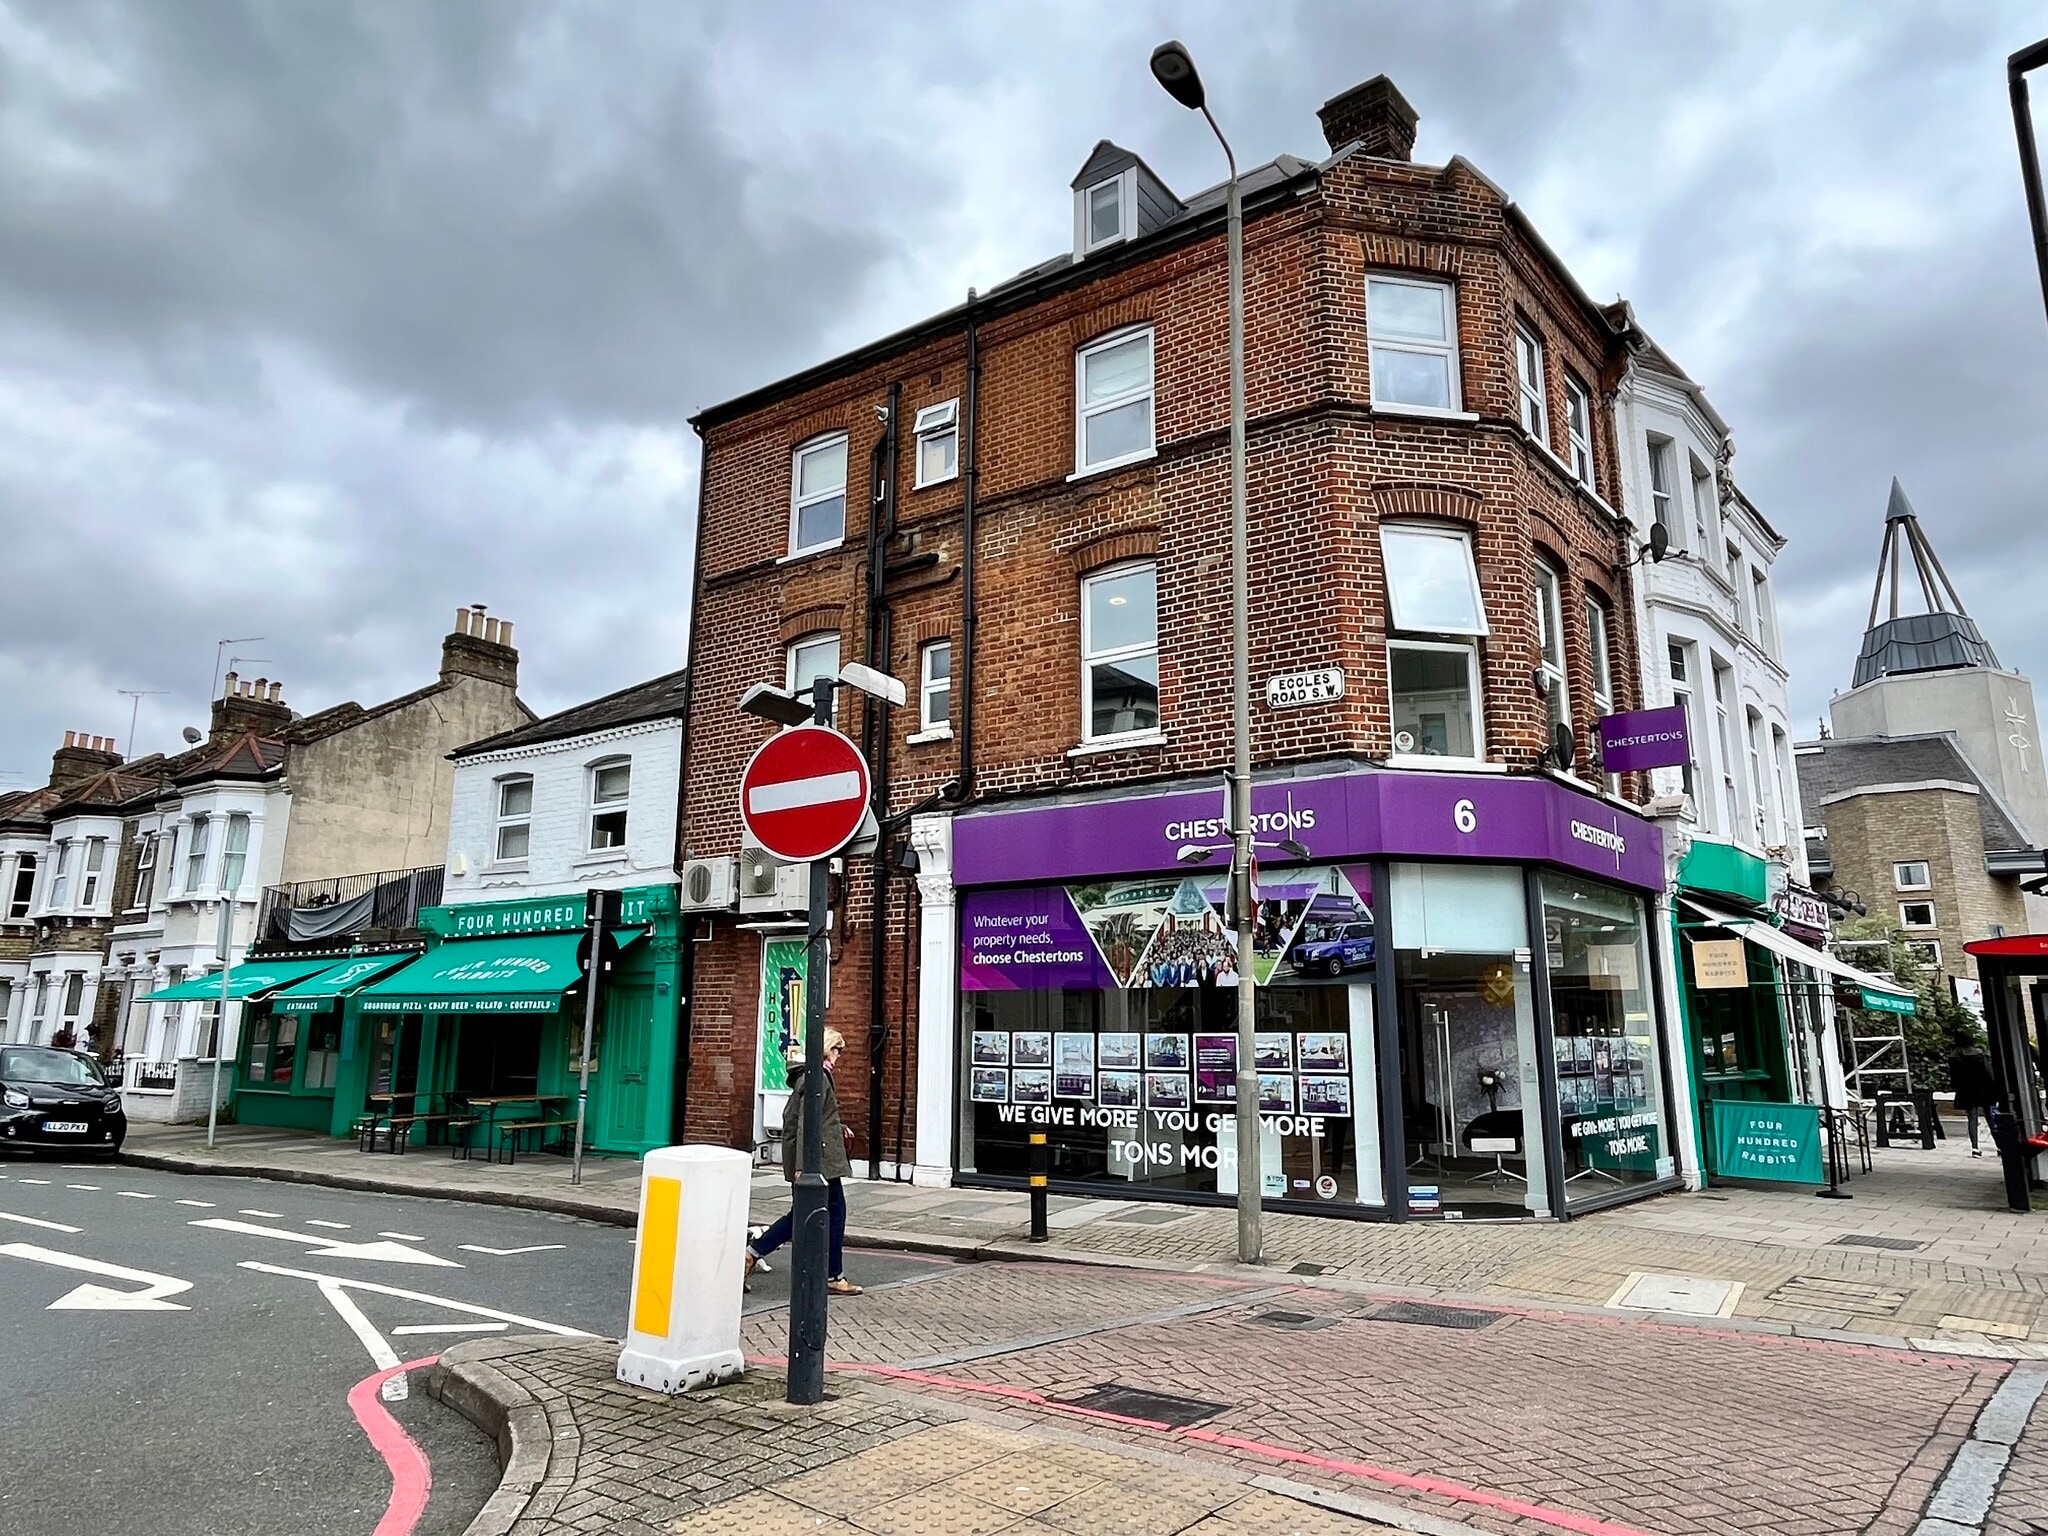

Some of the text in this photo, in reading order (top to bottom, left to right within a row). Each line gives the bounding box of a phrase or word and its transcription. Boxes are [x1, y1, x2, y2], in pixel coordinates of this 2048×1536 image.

[1278, 673, 1331, 691] ECCLES
[1271, 689, 1307, 705] ROAD
[1605, 730, 1684, 749] CHESTERTONS
[1164, 808, 1316, 842] CHESTRTONS
[1453, 798, 1477, 834] 6
[1570, 819, 1626, 854] CHESTERTONS
[458, 914, 494, 930] FOUR
[502, 906, 574, 927] HUNDRED
[973, 914, 1049, 929] Whatever your
[973, 931, 1054, 949] property needs,
[973, 950, 1084, 965] choose Chestertons
[402, 1002, 422, 1010] PIZZA
[451, 1002, 469, 1010] BEER
[475, 1001, 503, 1009] GELATO
[510, 1001, 551, 1009] COCKTAILS
[767, 992, 777, 1042] HOT
[998, 1104, 1325, 1137] WE GIVE MORE YOU GE MORE
[1571, 1122, 1583, 1138] WE
[1583, 1120, 1598, 1136] GIVE
[1598, 1117, 1616, 1133] MORE
[1619, 1115, 1631, 1130] YOU
[1749, 1120, 1783, 1131] FOUR
[1737, 1136, 1798, 1148] HUNDRED
[1111, 1140, 1238, 1169] TONS MOR
[1741, 1151, 1797, 1164] RABBITS
